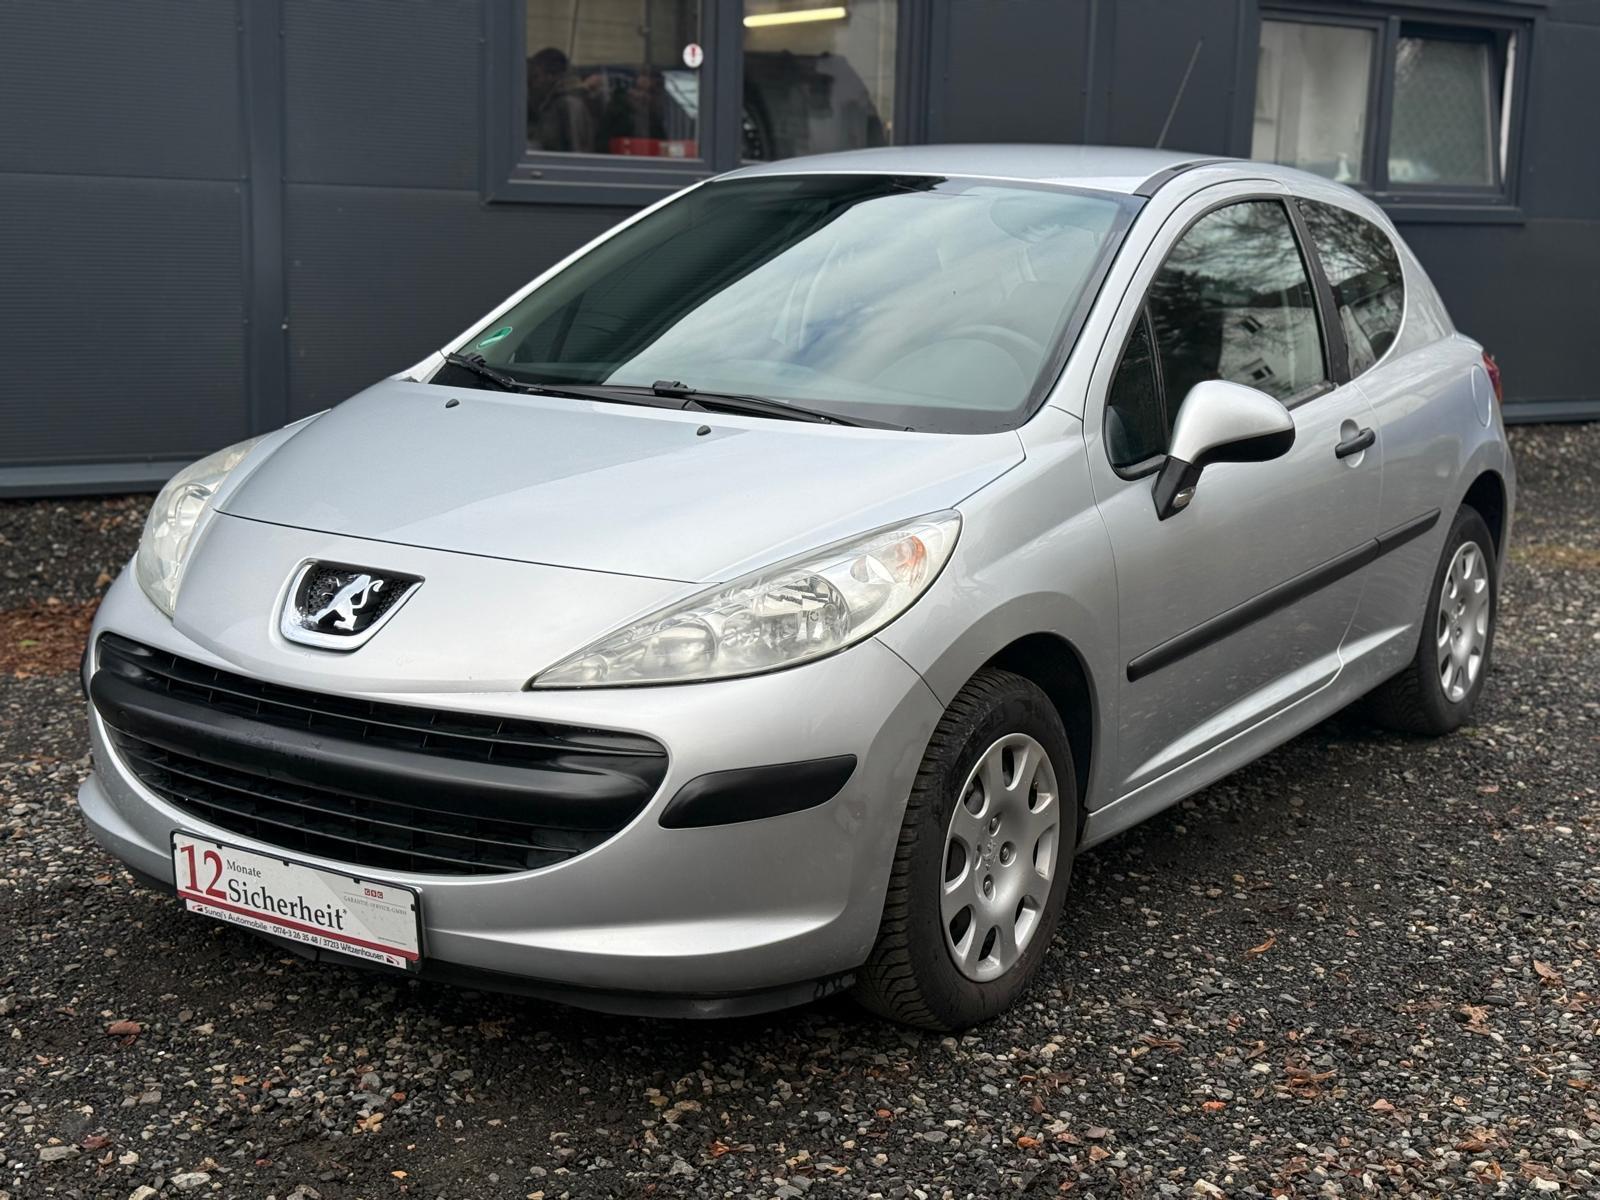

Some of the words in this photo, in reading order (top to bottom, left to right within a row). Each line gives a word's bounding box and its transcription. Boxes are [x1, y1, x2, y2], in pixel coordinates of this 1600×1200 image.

[180, 844, 227, 901] 12
[227, 859, 261, 878] Monate
[228, 913, 268, 931] Automobile
[273, 925, 292, 937] 0174-3
[293, 931, 301, 940] 26
[302, 933, 309, 941] 35
[310, 935, 318, 943] 48
[323, 938, 340, 950] 37213
[340, 942, 385, 960] Witzenhausen
